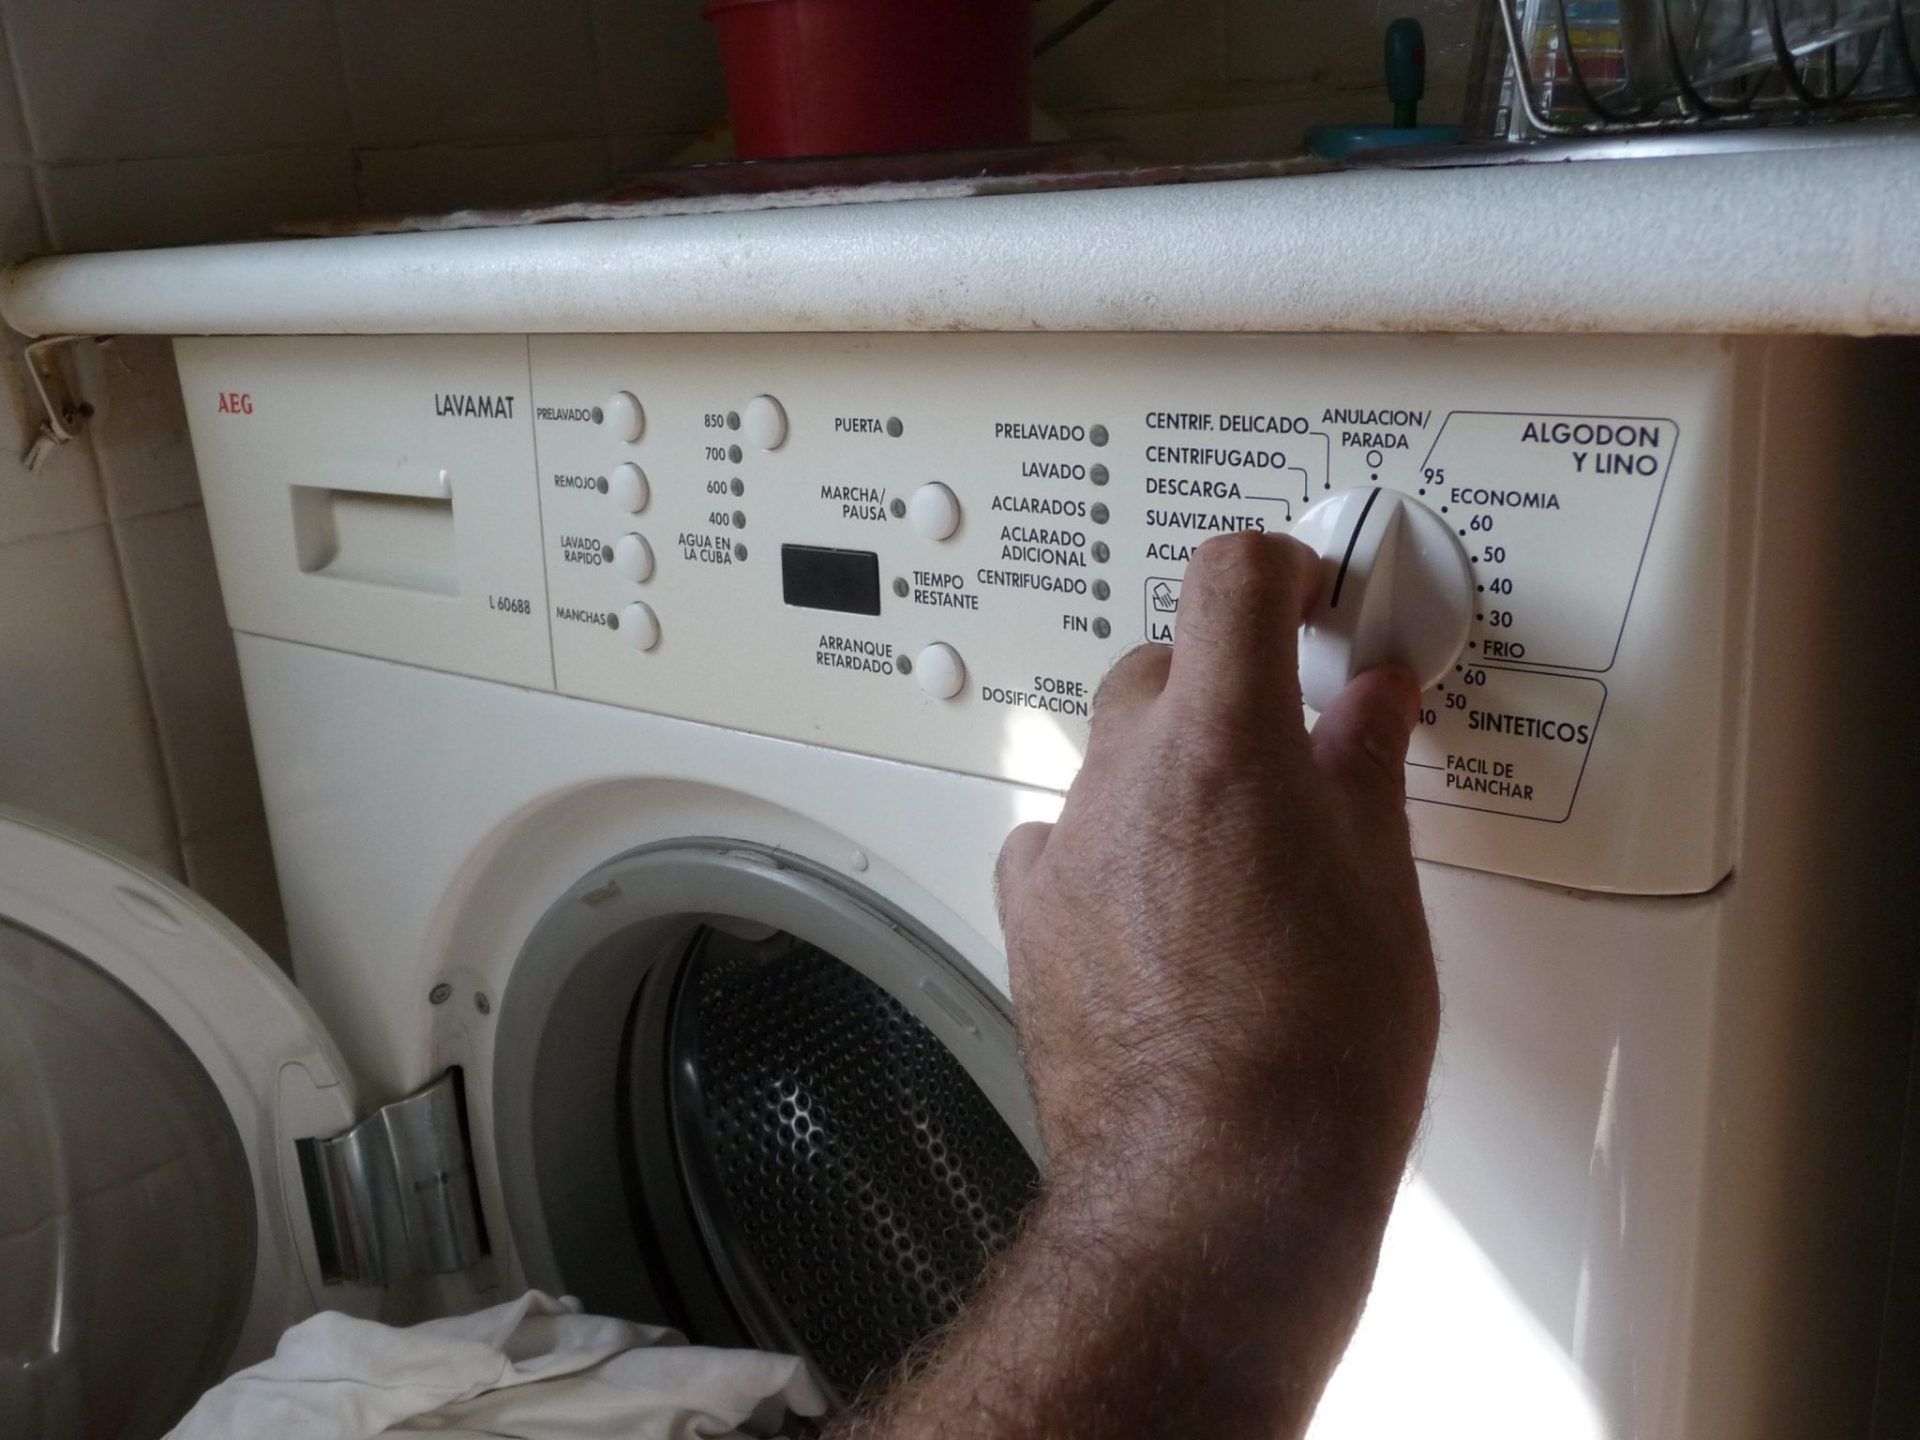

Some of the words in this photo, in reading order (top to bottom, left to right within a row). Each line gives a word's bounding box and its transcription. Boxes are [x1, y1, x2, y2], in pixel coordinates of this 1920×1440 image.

[218, 393, 253, 414] AEG
[435, 394, 514, 419] LAVAMAT
[537, 407, 591, 421] PRELAVADO
[704, 414, 724, 428] 850
[1146, 412, 1214, 431] CENTRIF.
[1220, 415, 1309, 434] DELICADO
[1322, 408, 1431, 430] ANULACION/
[835, 418, 883, 434] PUERTA
[995, 423, 1085, 442] PRELAVADO
[1521, 422, 1659, 447] ALGODON
[1342, 432, 1409, 449] PARADA
[705, 447, 726, 461] 700
[1146, 446, 1286, 469] CENTRIFUGADO
[1572, 451, 1588, 472] Y
[1595, 453, 1658, 476] LINO
[1022, 462, 1086, 480] LAVADO
[1424, 468, 1445, 485] 95
[554, 475, 596, 490] REMOJO
[707, 480, 727, 494] 600
[1146, 478, 1241, 499] DESCARGA
[821, 485, 886, 503] MARCHA/
[1451, 488, 1560, 510] ECONOMIA
[842, 505, 887, 522] PAUSA
[991, 496, 1086, 517] ACLARADOS
[709, 512, 729, 526] 400
[1146, 509, 1264, 533] SUAVIZANTES
[1470, 515, 1493, 532] 60
[561, 535, 600, 550] LAVADO
[678, 533, 712, 549] AGUA
[715, 536, 731, 550] EN
[1000, 526, 1085, 547] ACLARADO
[564, 550, 602, 565] RAPIDO
[684, 548, 698, 560] LA
[700, 550, 732, 565] CUBA
[1001, 545, 1087, 567] ADICIONAL
[1483, 546, 1505, 563] 50
[913, 571, 964, 590] TIEMPO
[977, 569, 1087, 595] CENTRIFUGADO
[1489, 578, 1513, 595] 40
[489, 595, 495, 609] L
[497, 596, 531, 615] 60688
[914, 590, 979, 610] RESTANTE
[557, 607, 606, 626] MANCHAS
[1063, 615, 1088, 632] FIN
[1489, 611, 1513, 628] 30
[819, 635, 892, 658] ARRANQUE
[1483, 640, 1525, 658] FRIO
[816, 652, 893, 675] RETARDADO
[1034, 676, 1088, 698] SOBRE-
[1464, 669, 1486, 686] 60
[982, 686, 1088, 717] DOSIFICACION
[1445, 693, 1467, 710] 50
[1468, 710, 1589, 744] SINTETICOS
[1447, 755, 1488, 776] FACIL
[1493, 762, 1514, 778] DE
[1446, 773, 1533, 800] PLANCHAR
